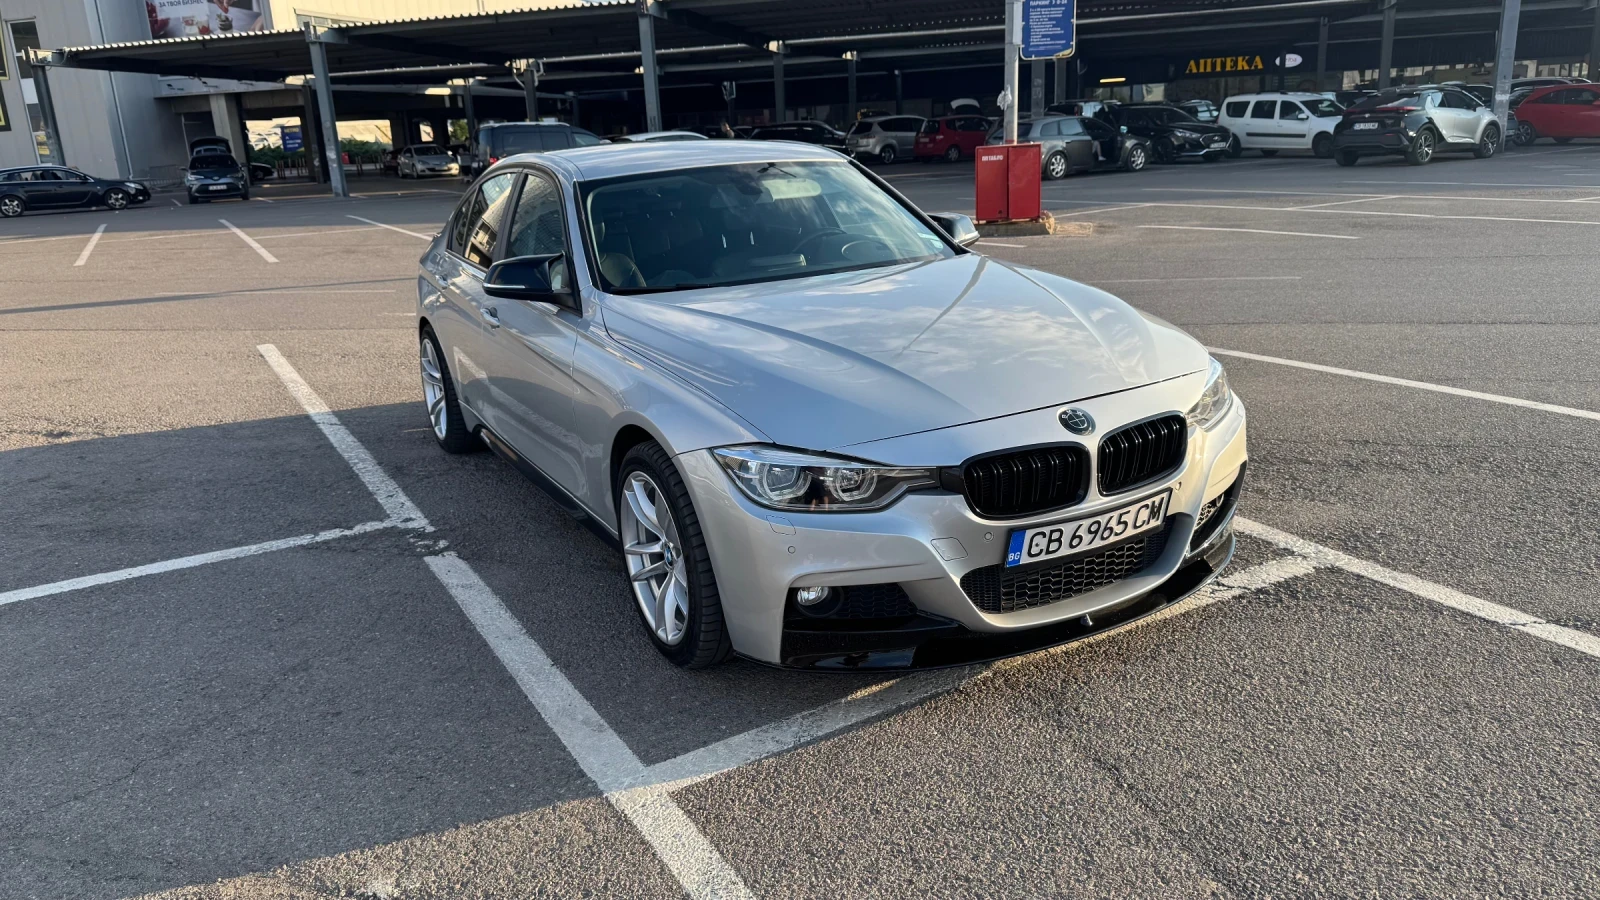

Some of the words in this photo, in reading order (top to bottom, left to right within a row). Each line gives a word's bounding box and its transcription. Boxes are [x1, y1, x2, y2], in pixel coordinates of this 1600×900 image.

[1185, 55, 1264, 74] АПТЕКА
[1026, 528, 1064, 558] CB
[1068, 510, 1130, 549] 6965
[1133, 496, 1165, 530] CM
[1008, 551, 1020, 562] BG
